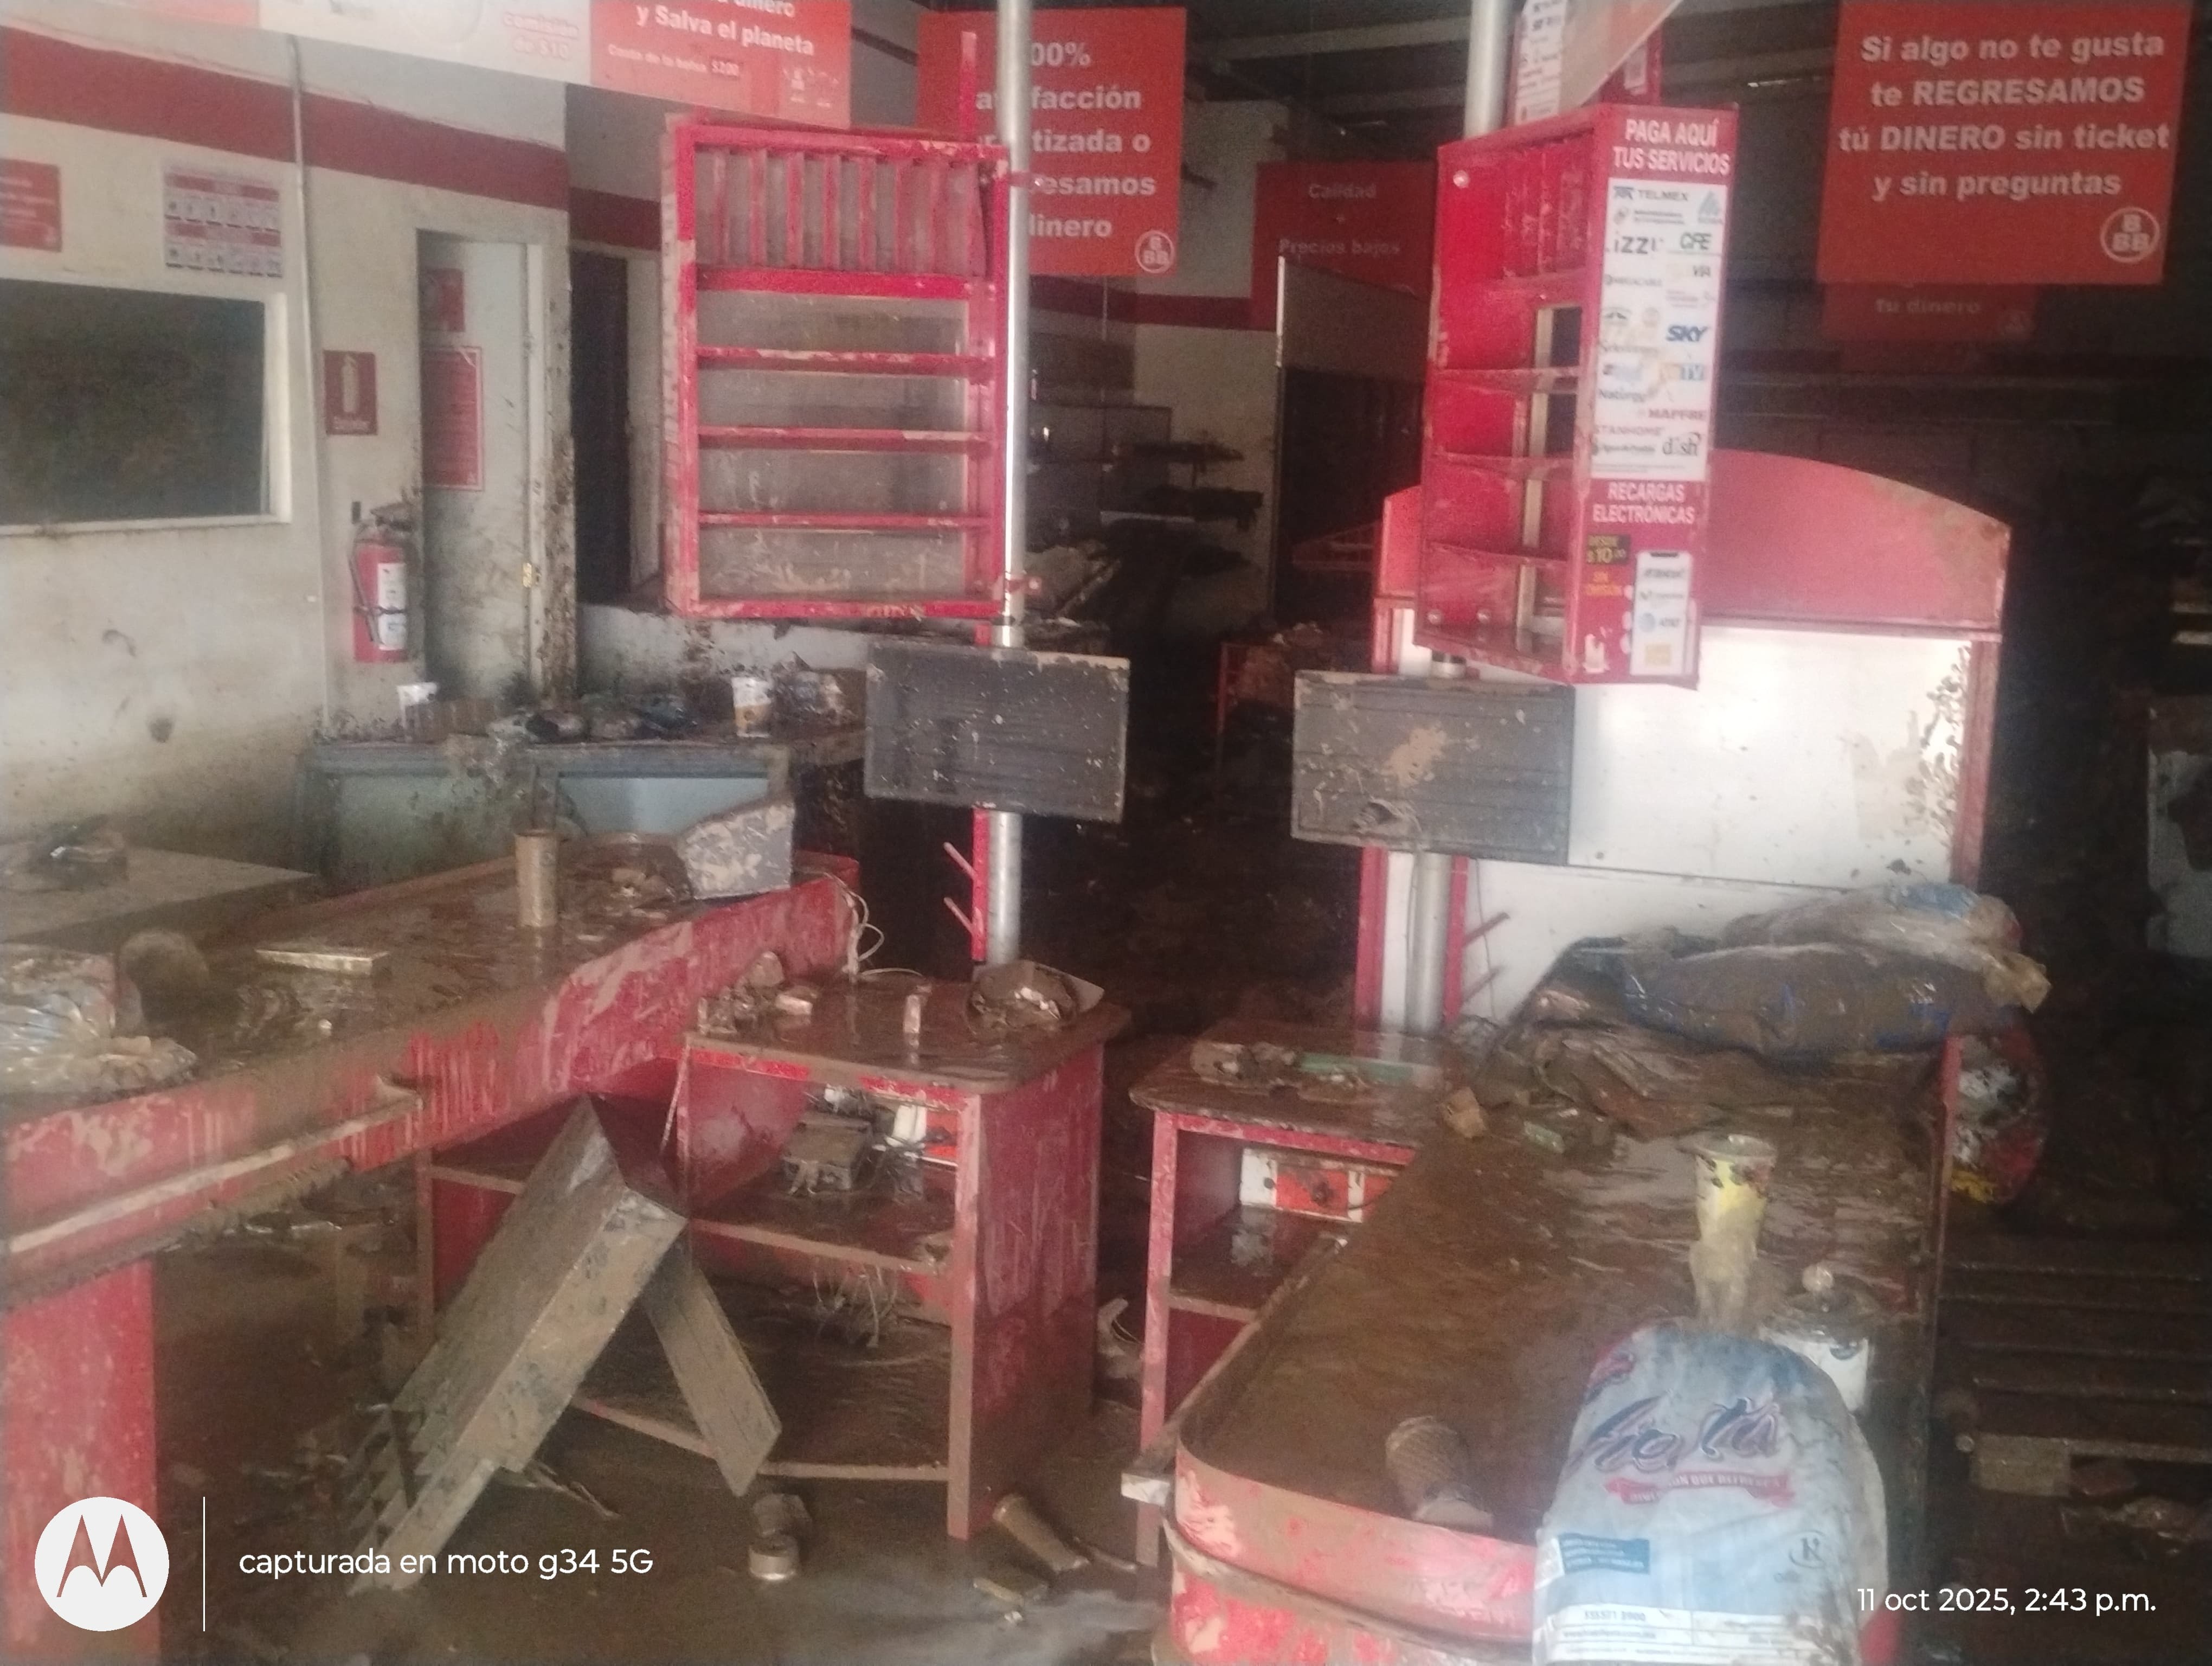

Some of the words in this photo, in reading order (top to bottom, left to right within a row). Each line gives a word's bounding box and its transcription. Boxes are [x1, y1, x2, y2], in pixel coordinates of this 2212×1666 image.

[636, 5, 649, 27] y
[654, 4, 713, 35] Salva
[717, 20, 737, 40] el
[742, 25, 814, 55] planeta
[1031, 42, 1091, 68] 00%
[1862, 35, 1891, 62] Si
[1901, 36, 1969, 67] algo
[1979, 38, 2017, 59] no
[2029, 33, 2061, 58] te
[2070, 32, 2165, 63] gusta
[1871, 82, 1902, 107] te
[1913, 76, 2145, 106] REGRESAMOS
[1131, 133, 1152, 152] o
[1625, 118, 1671, 144] PAGA
[1880, 125, 2005, 151] DINERO
[2015, 126, 2063, 149] sin
[2074, 123, 2169, 150] ticket
[1613, 146, 1644, 169] TUS
[1648, 148, 1731, 176] SERVICIOS
[1638, 189, 1688, 201] TELMEX
[1871, 176, 1892, 202] y
[1900, 171, 1947, 196] sin
[1957, 171, 2122, 201] preguntas
[1607, 482, 1684, 502] RECARGAS
